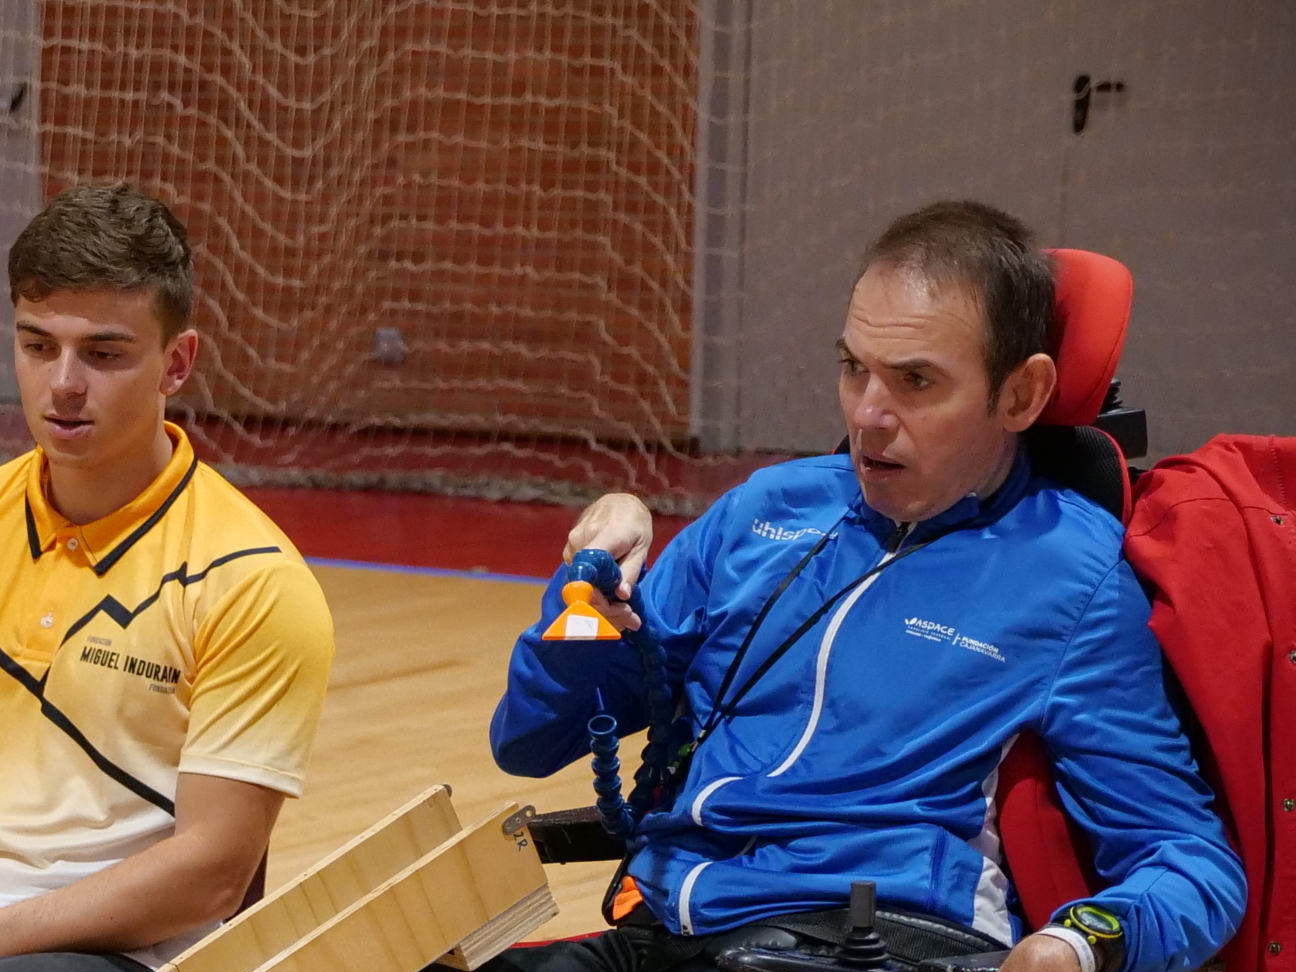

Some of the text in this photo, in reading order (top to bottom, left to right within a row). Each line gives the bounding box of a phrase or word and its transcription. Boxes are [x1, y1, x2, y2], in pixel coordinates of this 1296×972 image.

[915, 619, 955, 636] ASPACE
[80, 646, 181, 684] MIGUEL INDURAIN
